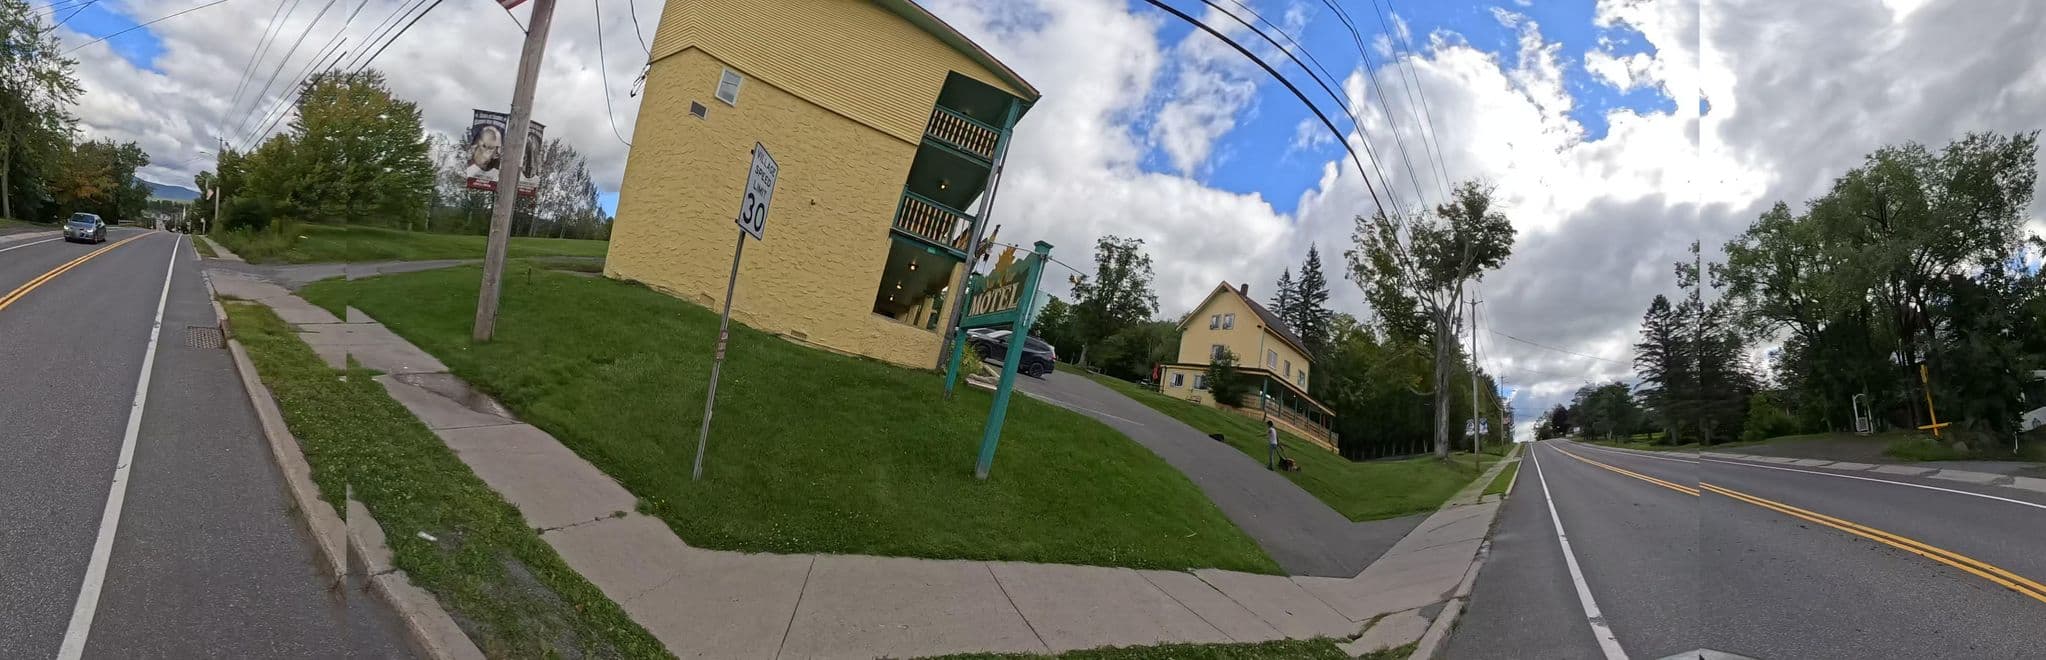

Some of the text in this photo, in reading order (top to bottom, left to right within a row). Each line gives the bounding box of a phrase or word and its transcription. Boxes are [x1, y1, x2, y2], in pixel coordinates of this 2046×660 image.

[755, 165, 771, 188] SPEED
[757, 149, 776, 178] VILLAGE
[753, 180, 767, 198] LIMIT
[743, 192, 765, 232] 30
[968, 282, 1020, 317] MOTEL
